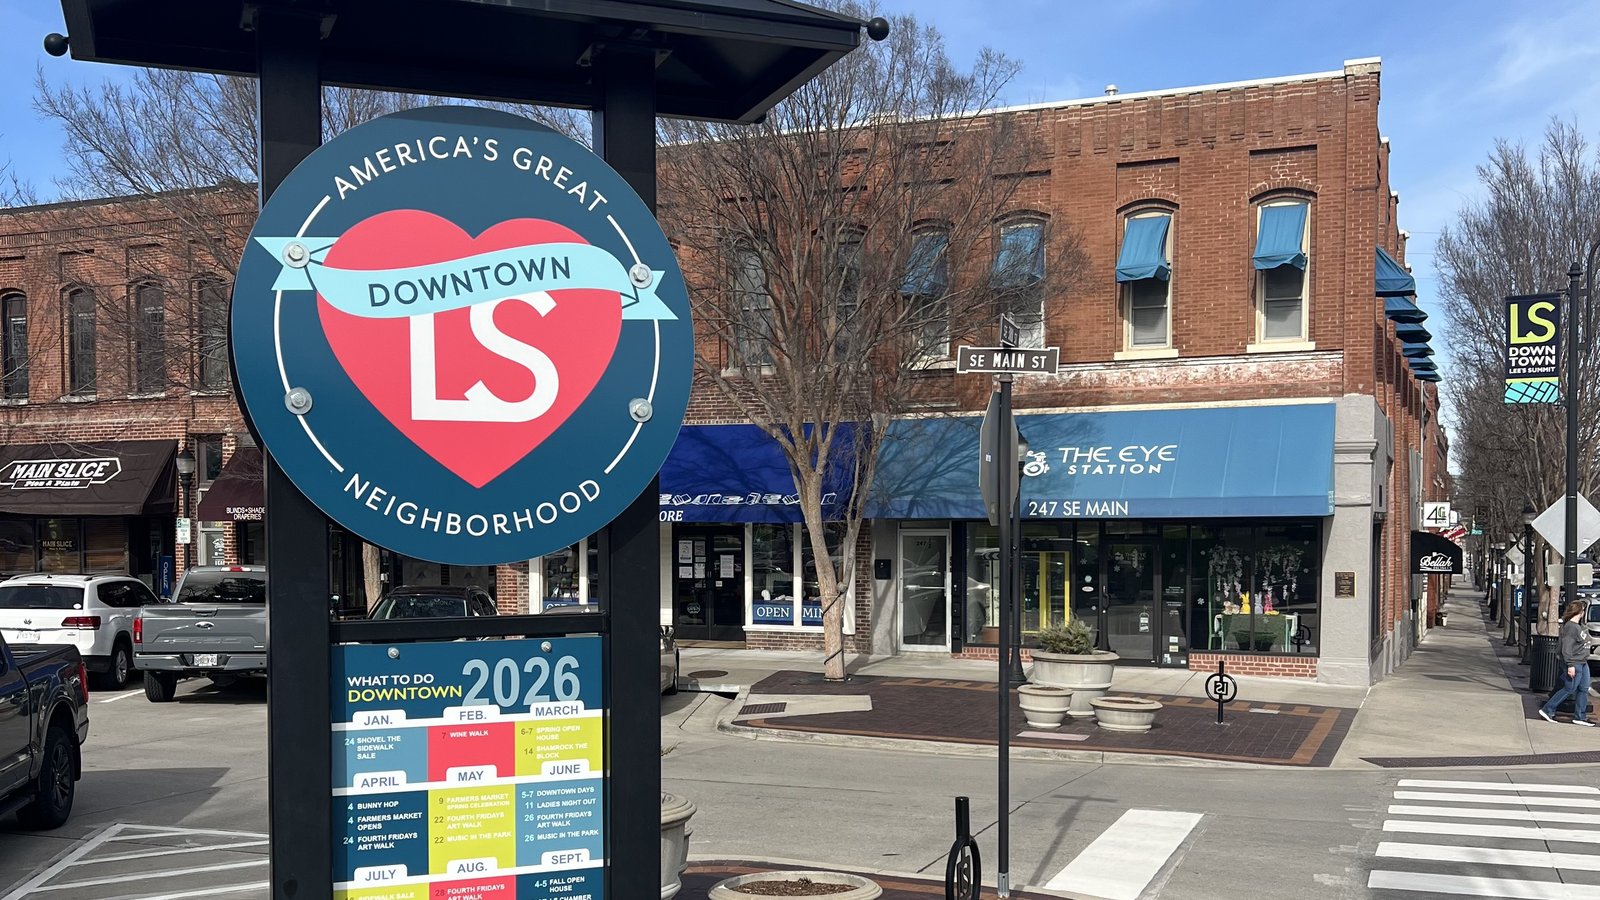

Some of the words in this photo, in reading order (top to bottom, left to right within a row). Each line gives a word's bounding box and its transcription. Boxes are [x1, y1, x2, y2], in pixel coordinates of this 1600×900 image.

[333, 135, 499, 200] AMERICA'S
[512, 146, 608, 212] GREAT
[368, 256, 571, 308] DOWNTOWN
[1509, 301, 1556, 345] LS
[409, 291, 558, 422] LS
[1509, 345, 1556, 357] DOWN
[969, 354, 985, 368] SE
[993, 353, 1025, 368] MAIN
[1031, 354, 1047, 369] ST
[1509, 355, 1556, 367] TOWN
[1528, 366, 1556, 374] SUMMIT
[1058, 446, 1112, 464] THE
[1118, 444, 1178, 463] EYE
[9, 463, 56, 479] MAIN
[54, 461, 110, 478] SLICE
[1067, 463, 1163, 476] STATION
[344, 472, 601, 537] NEIGHBORHOOD
[1028, 501, 1058, 516] 247
[1063, 501, 1081, 516] SE
[1085, 500, 1129, 516] MAIN
[1420, 555, 1453, 567] Bellah
[756, 606, 790, 618] OPEN
[347, 675, 389, 686] WHAT
[391, 675, 411, 685] TO
[413, 673, 435, 684] DO
[462, 655, 581, 708] 2026
[348, 685, 462, 702] DOWNTOWN
[460, 710, 487, 721] FEB.
[535, 705, 579, 716] MARCH
[364, 715, 393, 726] JAN.
[345, 738, 355, 746] 24
[356, 736, 386, 744] SHOVEL
[442, 732, 447, 740] 7
[536, 733, 560, 741] HOUSE
[356, 744, 394, 752] SIDEWALK
[536, 743, 574, 752] SHAMROCK
[536, 752, 560, 760] BLOCK
[458, 770, 484, 781] MAY
[550, 764, 581, 775] JUNE
[361, 776, 400, 788] APRIL
[521, 790, 534, 798] 5-7
[536, 788, 576, 797] DOWNTOWN
[577, 786, 595, 794] DAYS
[357, 802, 382, 810] BUNNY
[383, 800, 399, 808] HOP
[536, 801, 560, 809] LADIES
[347, 816, 354, 824] 4
[357, 814, 391, 823] FARMERS
[392, 812, 422, 820] MARKET
[536, 813, 564, 821] FOURTH
[564, 810, 592, 819] FRIDAYS
[357, 823, 382, 831] OPENS
[343, 836, 354, 844] 24
[357, 835, 387, 843] FOURTH
[388, 832, 418, 841] FRIDAYS
[434, 836, 444, 844] 22
[524, 834, 534, 842] 26
[537, 832, 558, 840] MUSIC
[357, 843, 373, 851] ART
[373, 842, 395, 850] WALK
[551, 853, 584, 865] SEPT.
[457, 862, 487, 874] AUG.
[365, 869, 396, 881] JULY
[435, 889, 445, 897] 28
[447, 886, 475, 894] FOURTH
[476, 883, 505, 892] FRIDAYS
[534, 880, 548, 888] 4-5
[549, 885, 573, 893] HOUSE
